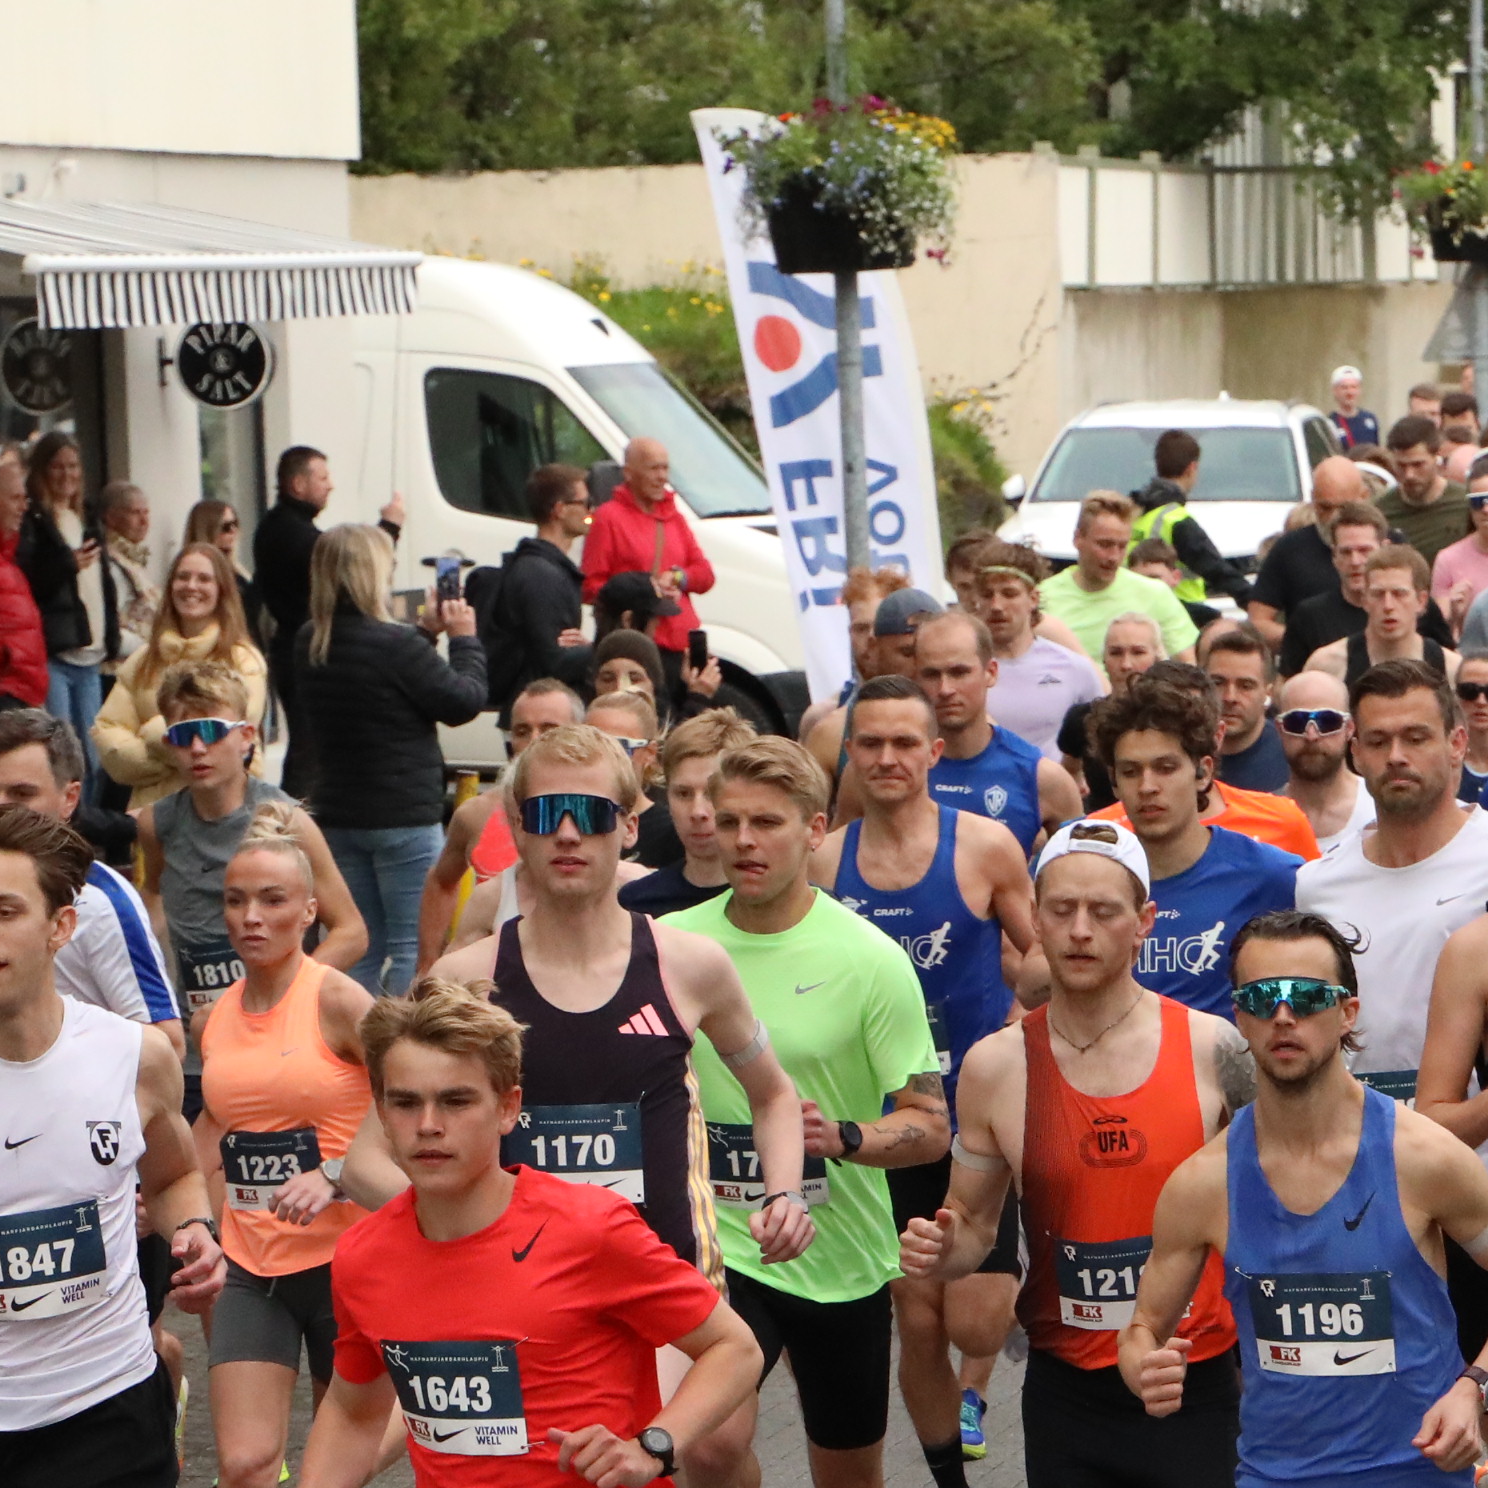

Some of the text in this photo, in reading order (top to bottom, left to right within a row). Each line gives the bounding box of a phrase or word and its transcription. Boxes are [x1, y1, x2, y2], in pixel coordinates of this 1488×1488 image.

[185, 324, 256, 355] PIPAR
[195, 370, 252, 400] SALT
[935, 784, 964, 793] CRAFT
[873, 908, 904, 917] CRAFT
[193, 959, 247, 987] 1810
[531, 1134, 616, 1166] 1170
[1097, 1130, 1129, 1153] UFA
[237, 1153, 302, 1181] 1223
[60, 1278, 100, 1296] VITAMIN
[1077, 1266, 1146, 1297] 121
[62, 1291, 86, 1304] WELL
[1275, 1303, 1364, 1336] 1196
[408, 1375, 493, 1412] 1643
[474, 1426, 518, 1436] VITAMIN
[476, 1436, 502, 1446] WELL
